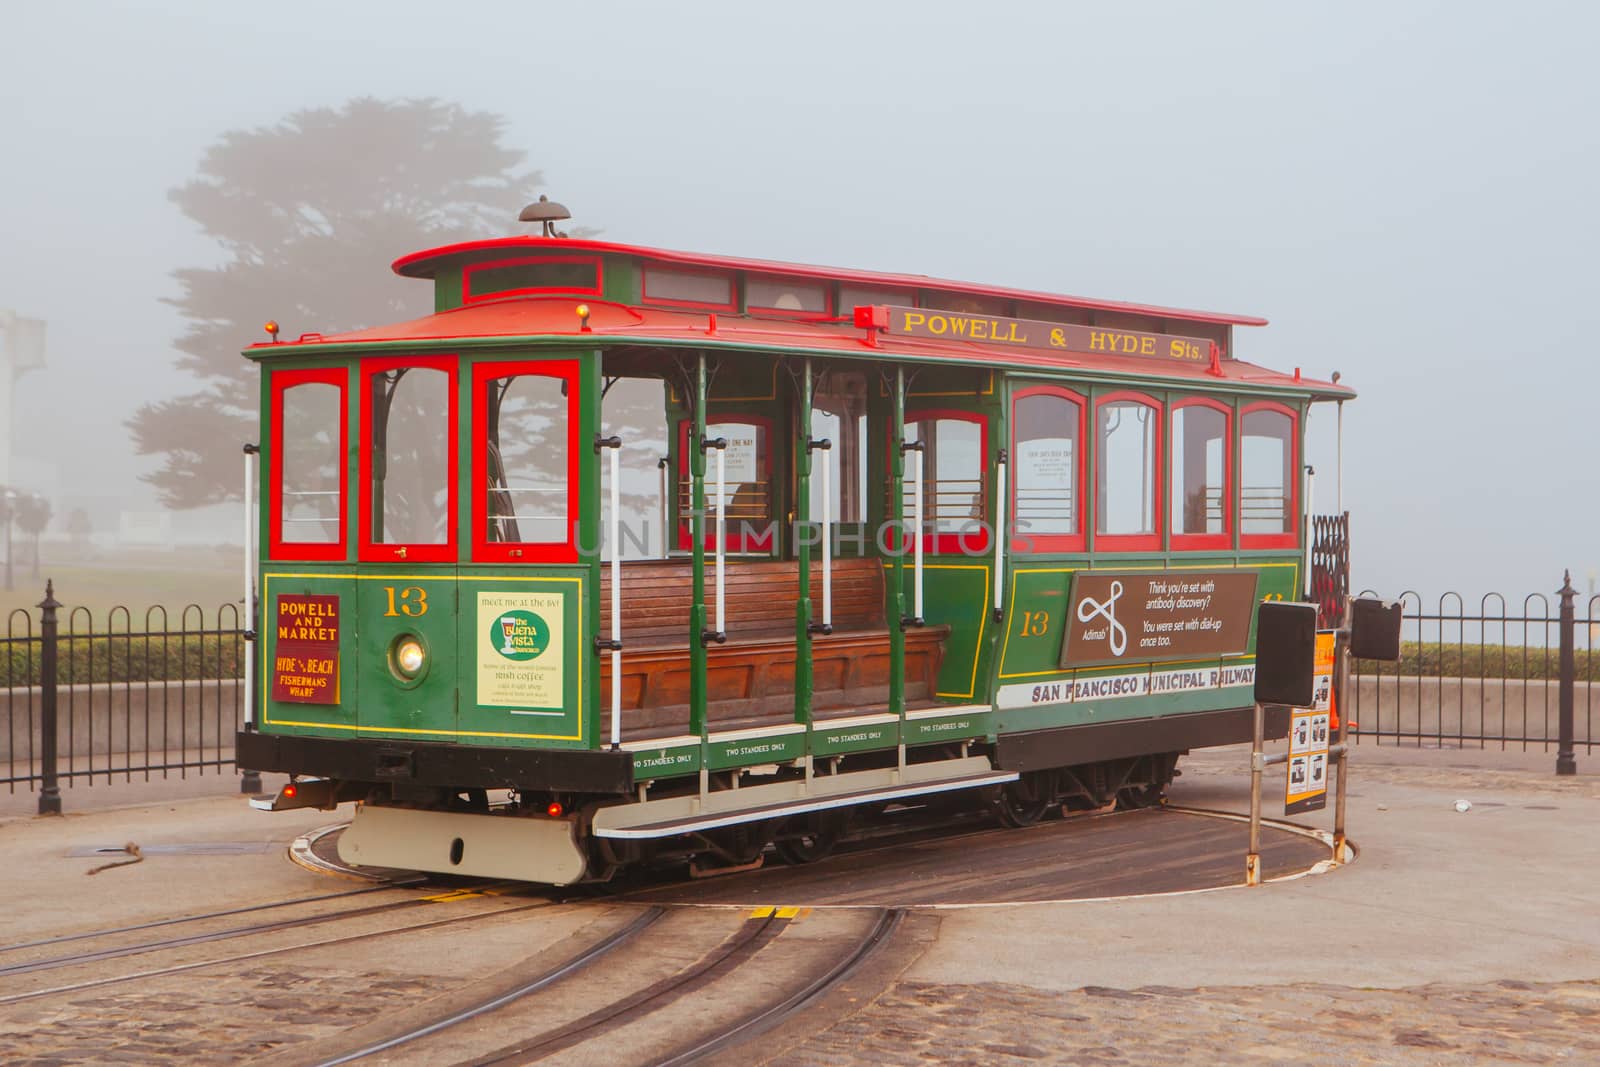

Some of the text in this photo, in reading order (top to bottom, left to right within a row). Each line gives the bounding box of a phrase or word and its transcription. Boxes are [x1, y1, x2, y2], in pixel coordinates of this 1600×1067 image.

[903, 312, 1202, 360] POWELL & HYDE Sts.
[1149, 580, 1215, 597] Think you're set with
[384, 586, 429, 617] 13
[1145, 595, 1211, 612] antibody discovery?
[280, 602, 336, 617] POWELL
[295, 617, 322, 627] AND
[1020, 611, 1049, 637] 13
[1143, 617, 1223, 633] You were set with dial-up
[279, 627, 336, 641] MARKET
[1140, 635, 1171, 648] once too.
[276, 657, 297, 673] HYDE
[307, 659, 334, 675] BEACH
[280, 675, 327, 687] FISHERMANS
[1032, 667, 1255, 703] SAN FRANCISCO MUNICIPAL RAILWAY
[289, 687, 315, 698] WHARF
[919, 721, 970, 733] TWO STANDEES ONLY
[827, 731, 882, 744] TWO STANDEES ONLY
[726, 743, 786, 757] TWO STANDEES ONLY
[643, 756, 675, 768] STANDEES
[677, 754, 693, 763] ONLY
